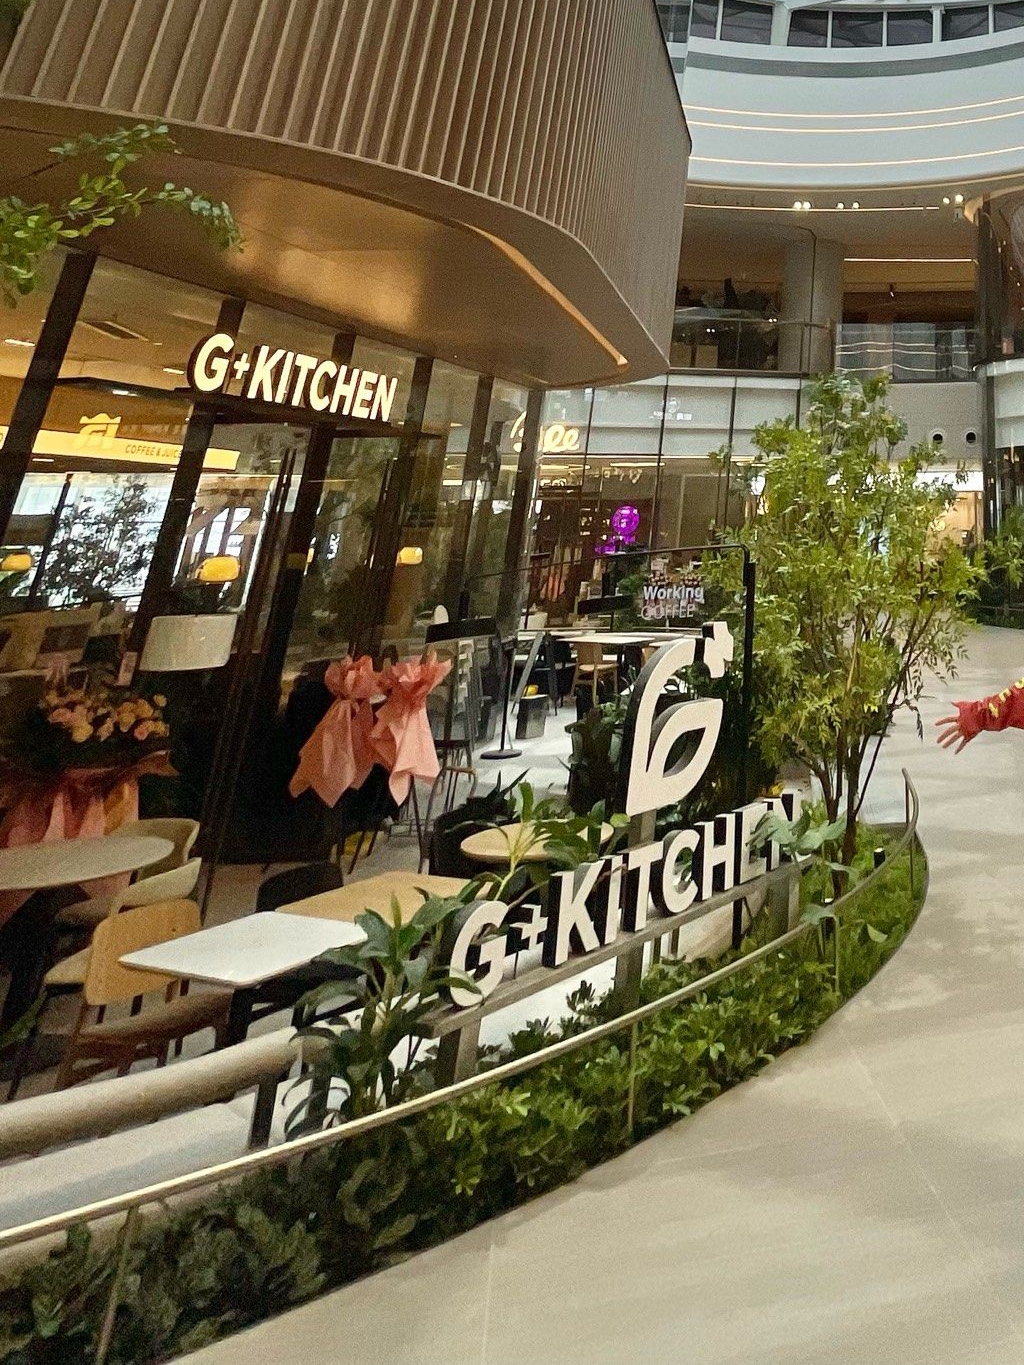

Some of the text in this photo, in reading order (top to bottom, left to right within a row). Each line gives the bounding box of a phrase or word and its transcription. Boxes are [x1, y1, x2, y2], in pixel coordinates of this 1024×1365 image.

[194, 333, 398, 422] G+KITCHEN
[125, 444, 156, 456] COFFEE
[643, 585, 705, 604] Working
[641, 603, 696, 621] COFFEE
